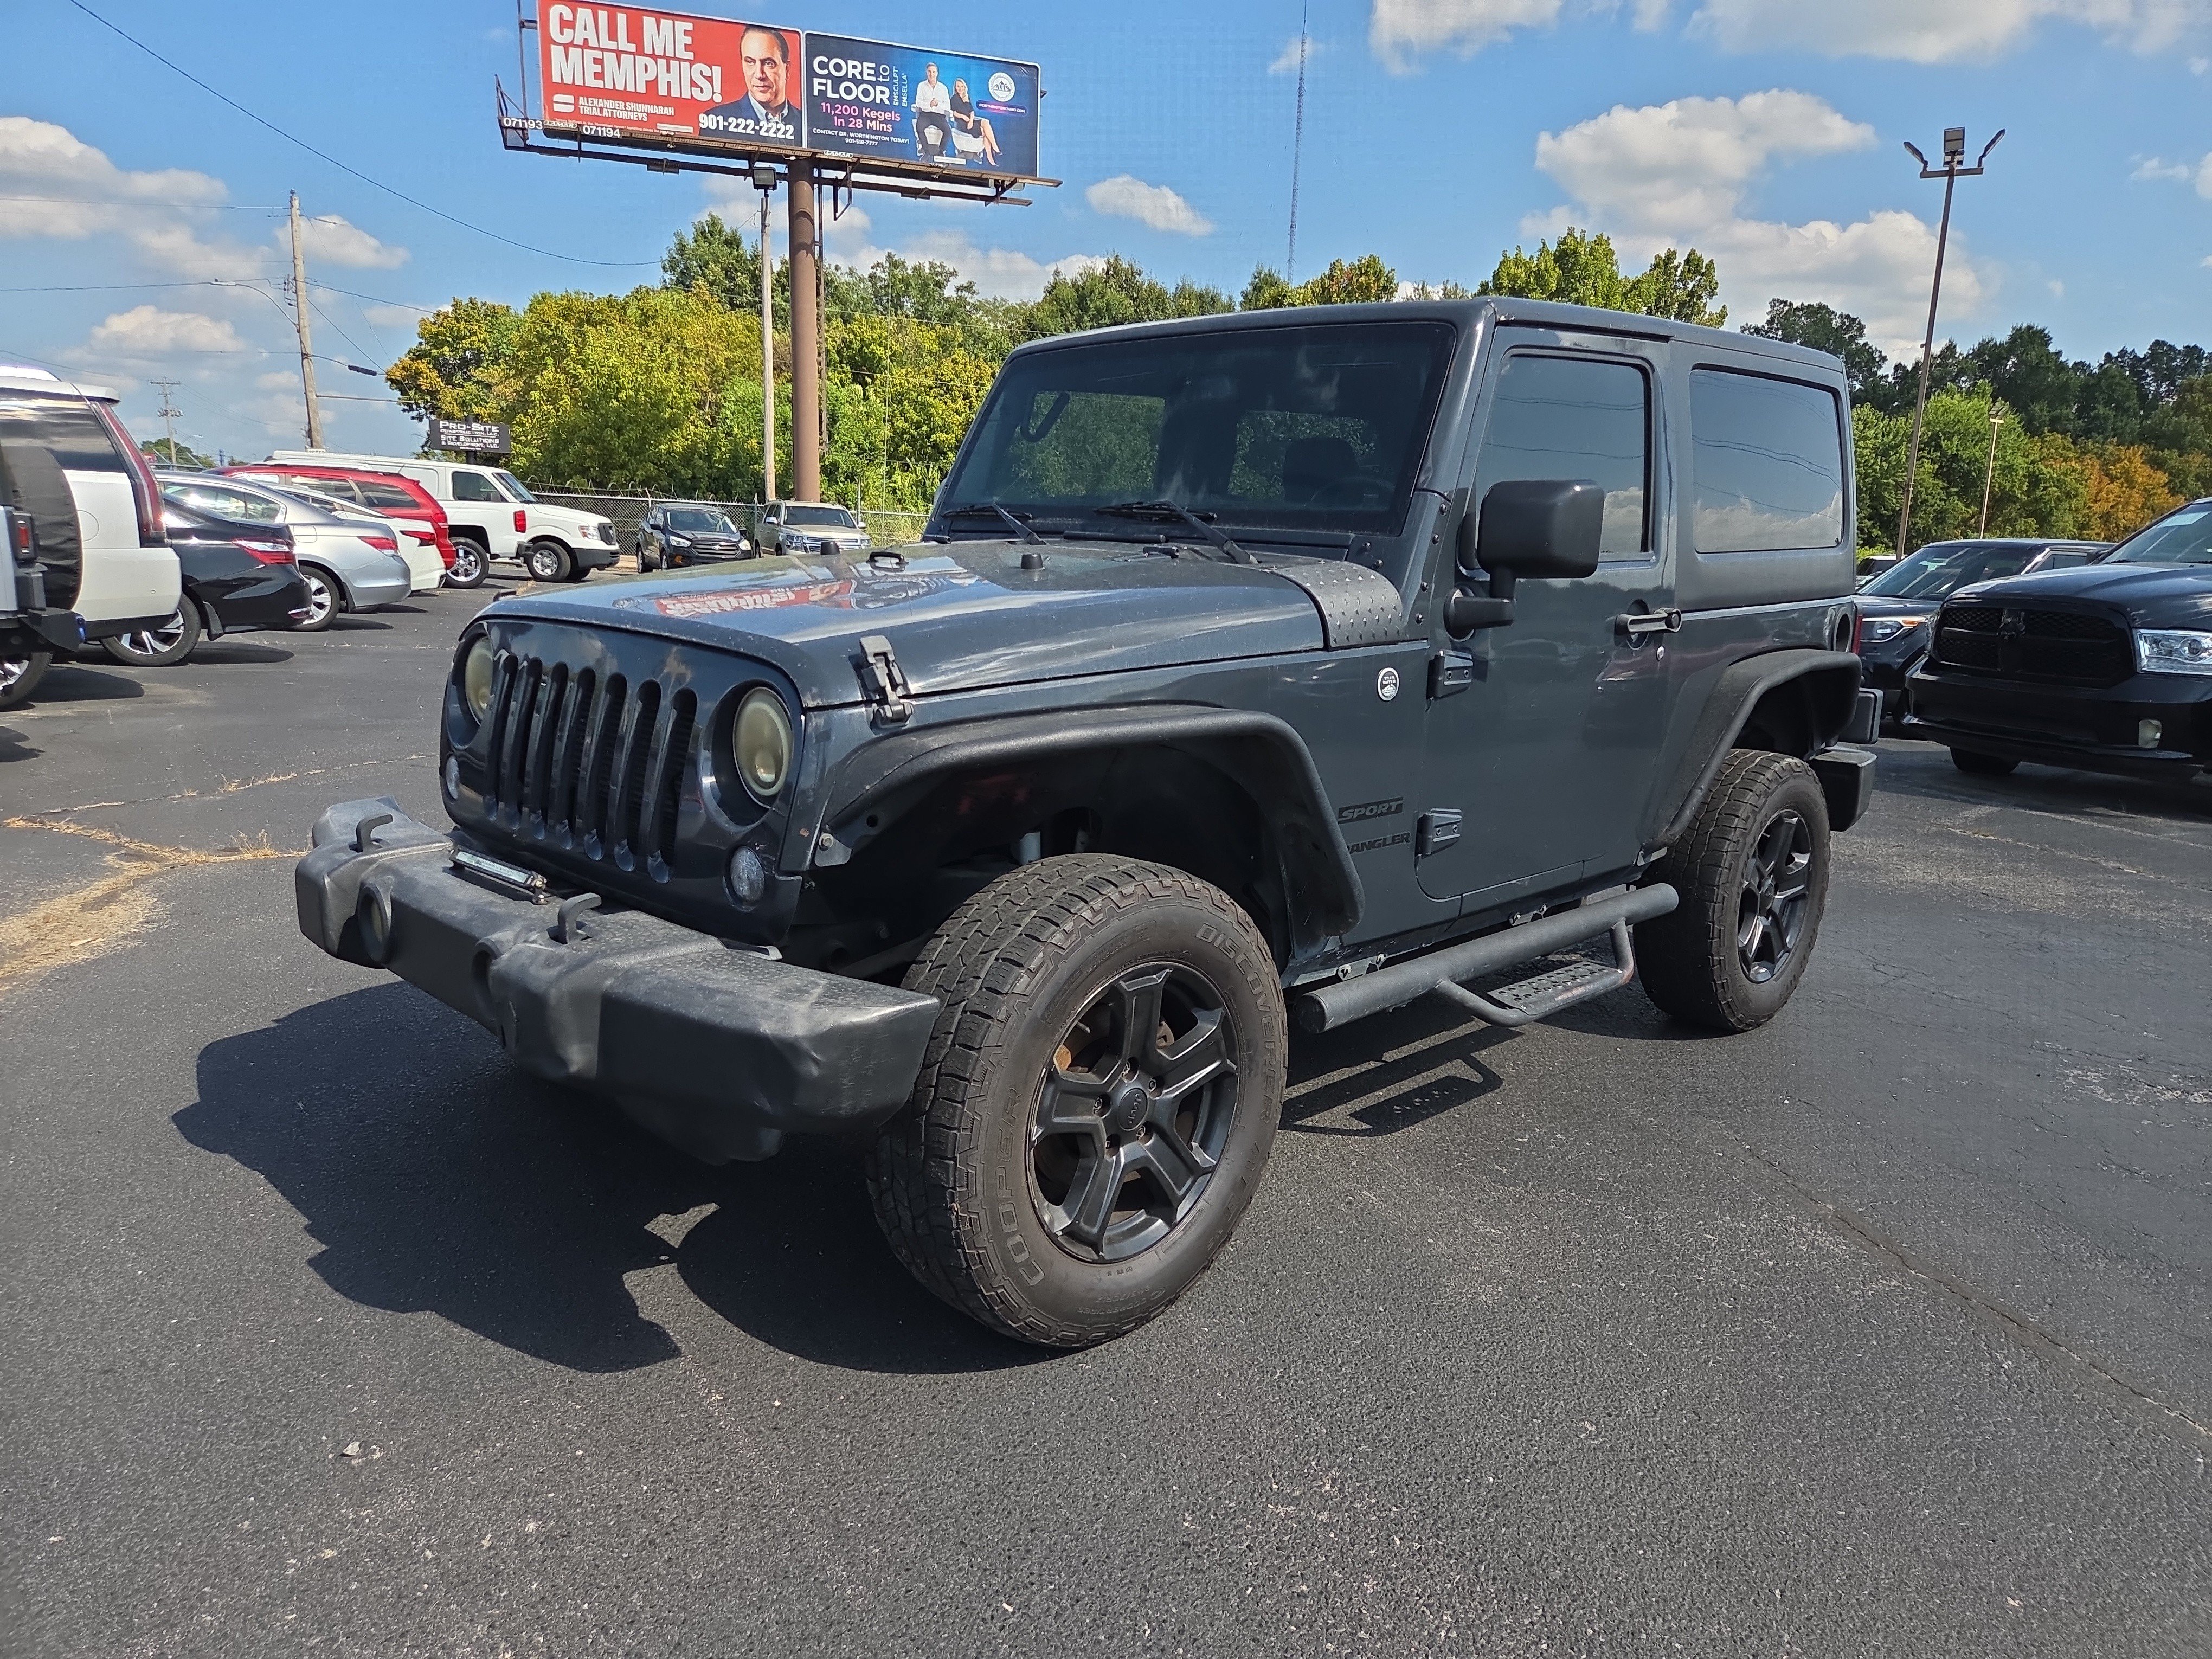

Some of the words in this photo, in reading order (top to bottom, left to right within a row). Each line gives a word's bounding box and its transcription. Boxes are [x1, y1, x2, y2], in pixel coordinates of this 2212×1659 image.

[549, 4, 636, 52] CALL
[643, 16, 694, 60] ME
[550, 45, 722, 104] MEMPHIS!
[813, 56, 876, 81] CORE
[877, 65, 890, 82] to
[813, 78, 890, 105] FLOOR
[578, 96, 625, 110] ALEXANDER
[626, 101, 674, 116] SHUNNARAH
[578, 106, 602, 116] TRIAL
[602, 107, 648, 121] ATTORNEYS
[821, 102, 859, 116] 11,200
[863, 107, 901, 122] Kegels
[503, 118, 543, 130] 071193
[582, 125, 621, 138] 071194
[699, 113, 794, 140] 901-222-2222
[834, 116, 845, 127] In
[848, 118, 863, 128] 28
[866, 120, 892, 132] Mins
[813, 128, 838, 136] CONTACT
[849, 132, 889, 142] WORTHINGTON
[459, 435, 499, 444] SOLUTIONS
[1338, 800, 1403, 821] SPORT
[1347, 832, 1411, 854] ANGLER
[1195, 923, 1276, 1123] DISCOVERER
[995, 1088, 1045, 1286] COOPER
